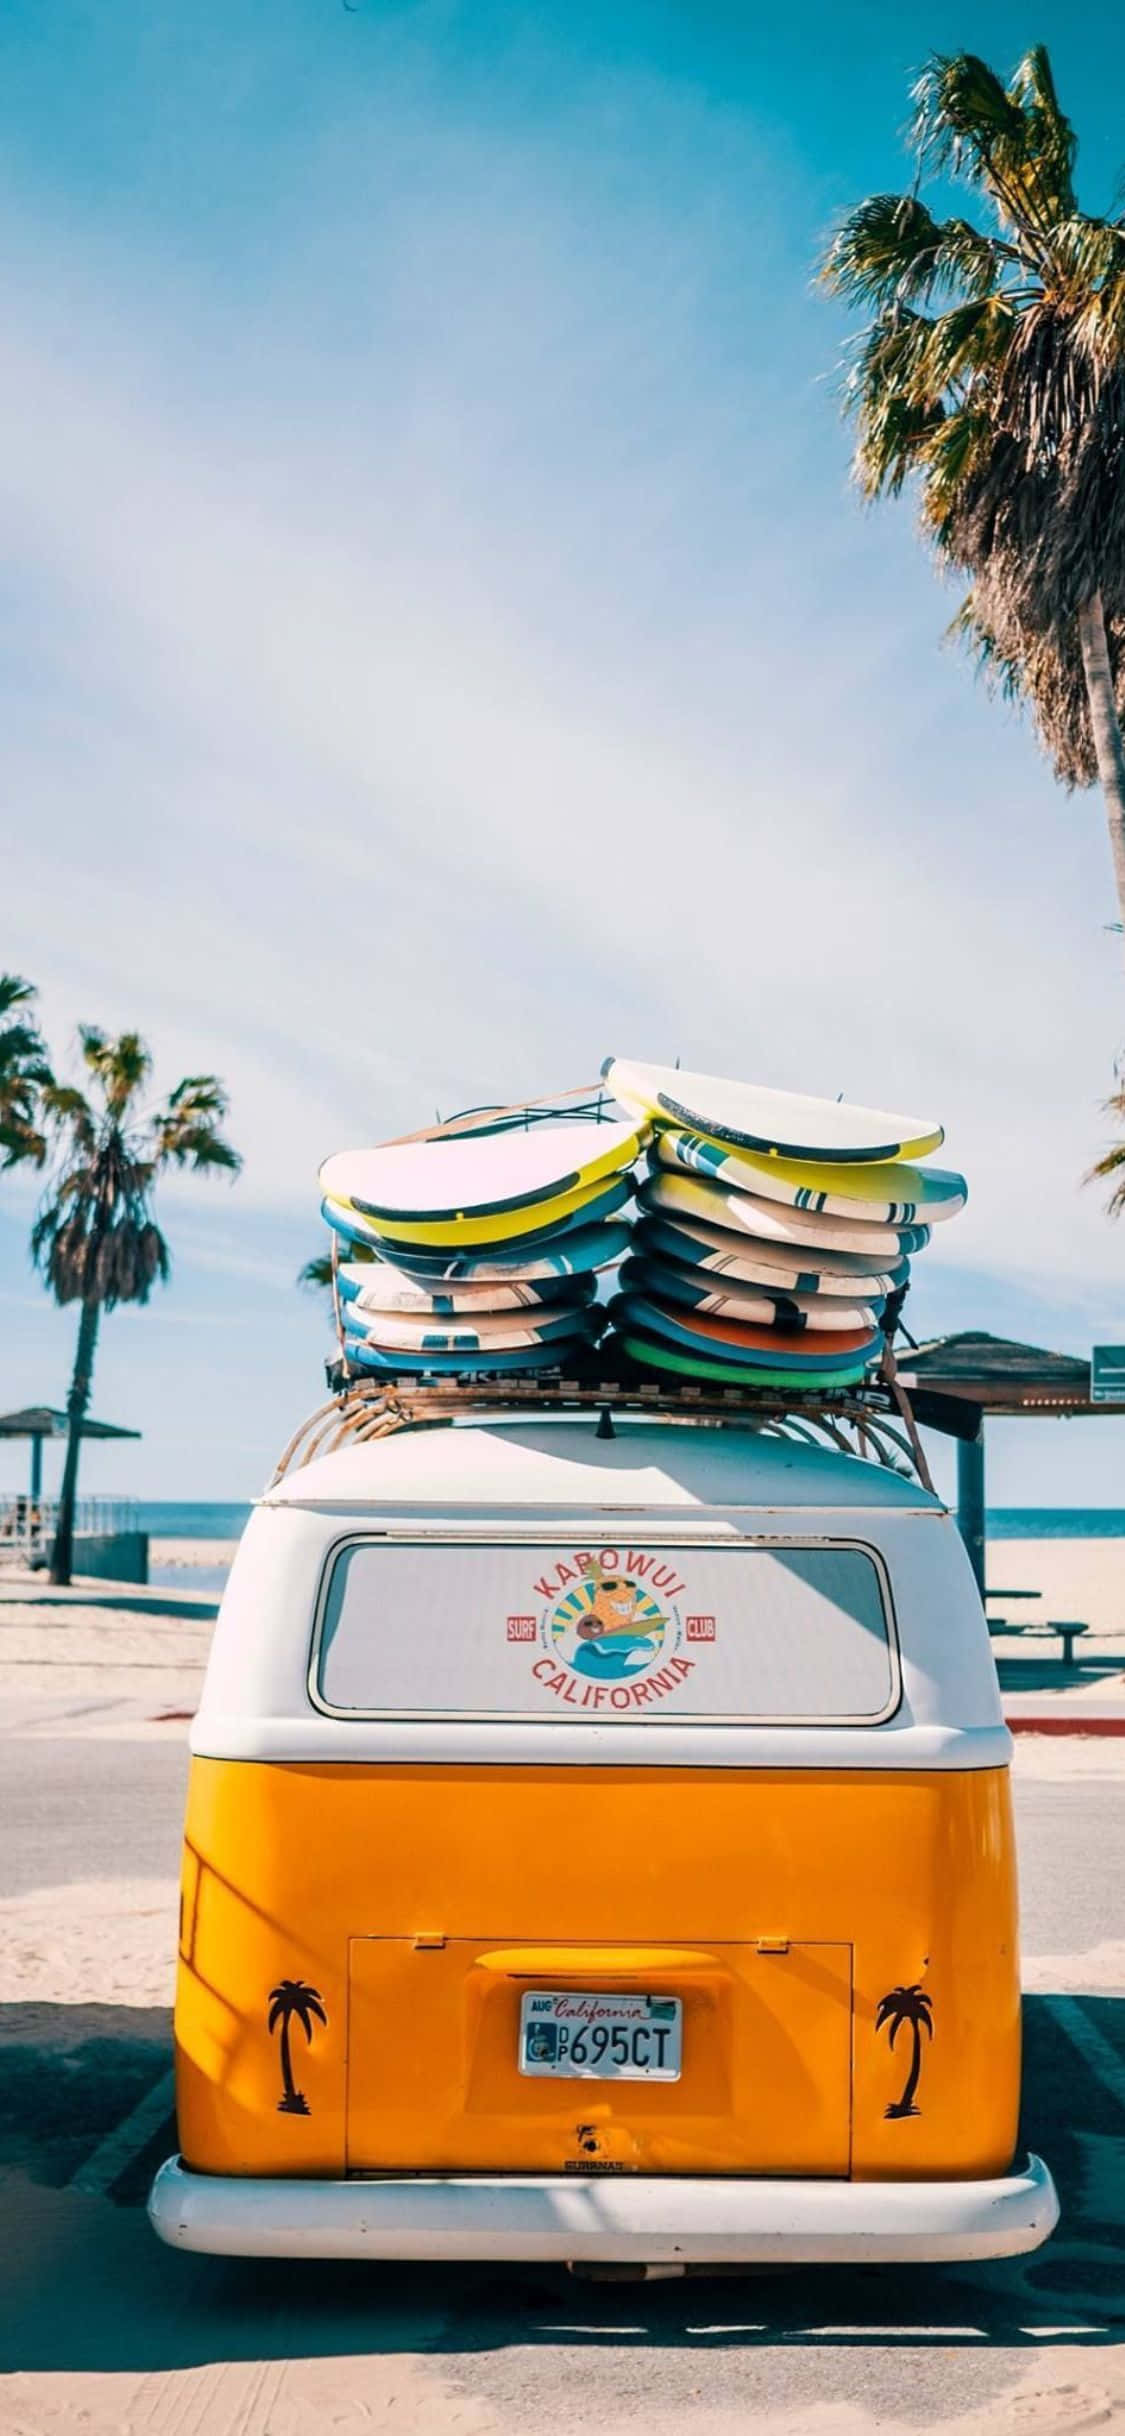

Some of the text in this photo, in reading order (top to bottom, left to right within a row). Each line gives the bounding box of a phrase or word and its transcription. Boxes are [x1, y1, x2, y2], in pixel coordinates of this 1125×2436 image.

[533, 1549, 686, 1600] KAPOWUI
[508, 1618, 535, 1640] SURF
[687, 1618, 715, 1640] CLUB
[532, 1657, 696, 1710] CALIFORNIA
[531, 1999, 650, 2024] AUG California
[570, 2026, 670, 2067] 695CT
